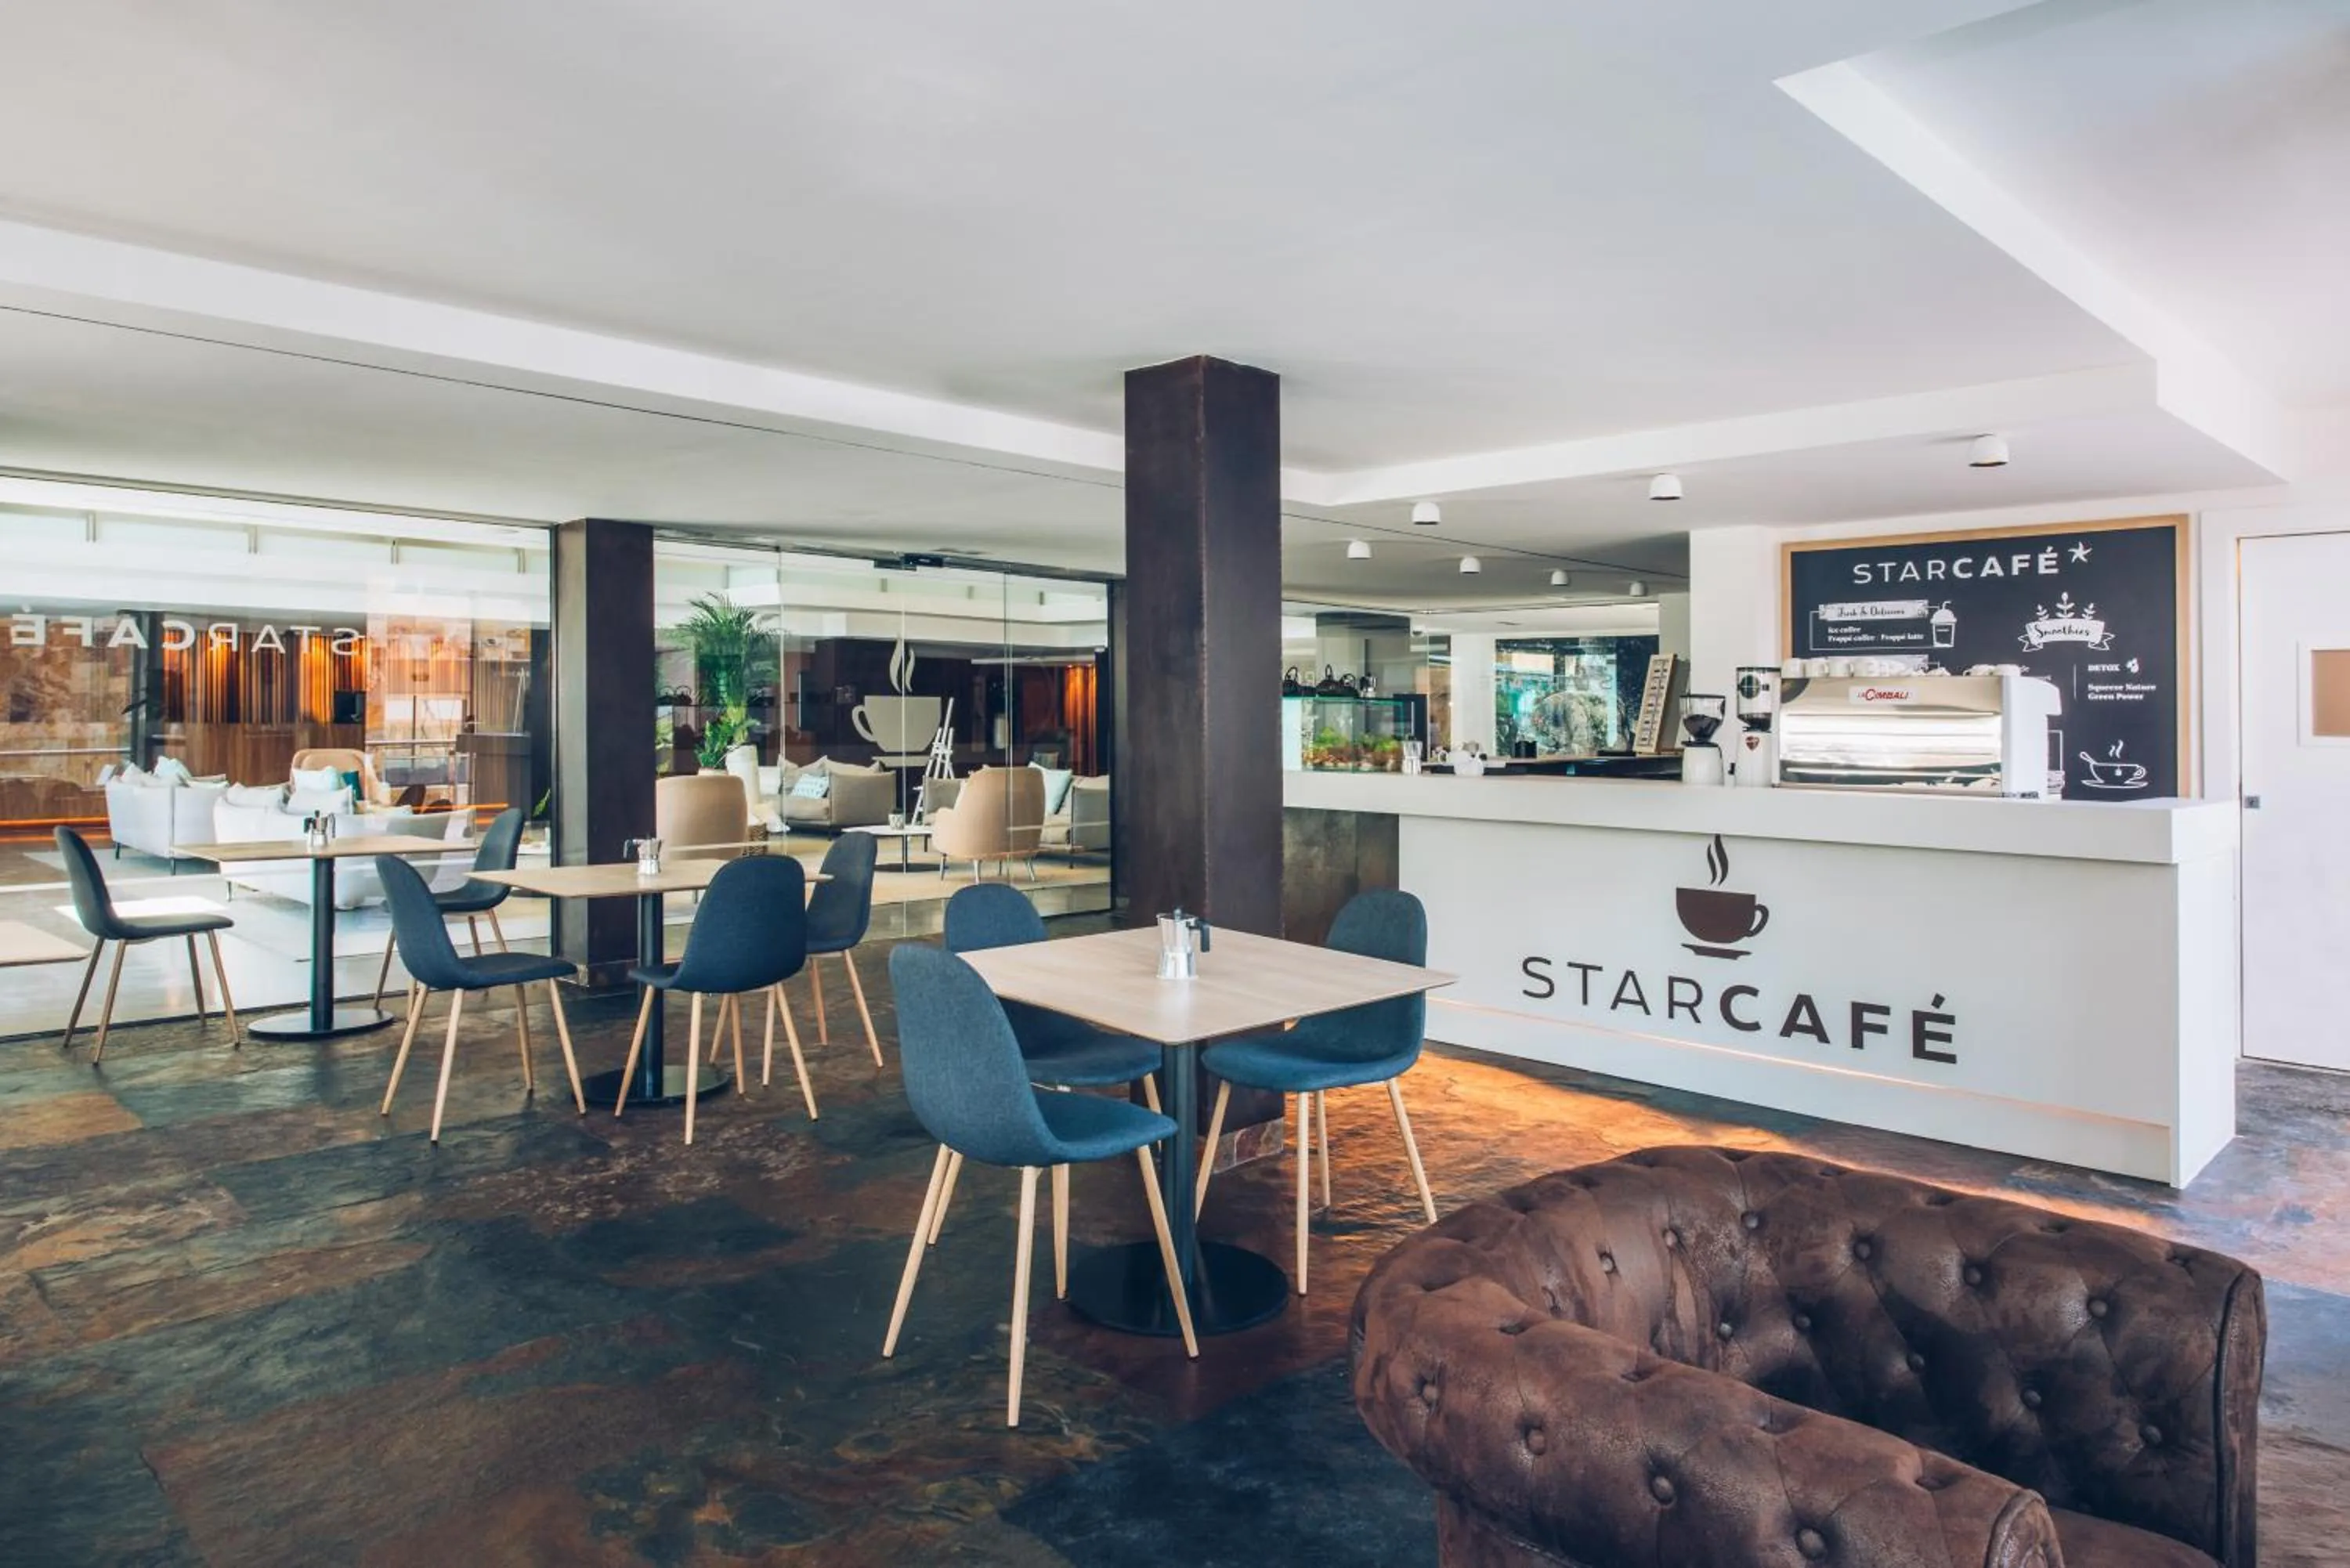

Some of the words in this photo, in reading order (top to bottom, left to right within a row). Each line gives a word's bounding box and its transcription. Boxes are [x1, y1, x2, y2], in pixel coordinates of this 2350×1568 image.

[1853, 546, 2059, 583] STARCAFÉ
[2034, 623, 2091, 638] Smoothies
[2088, 663, 2120, 672] DETOX
[1521, 956, 1958, 1064] STARCAFÉ
